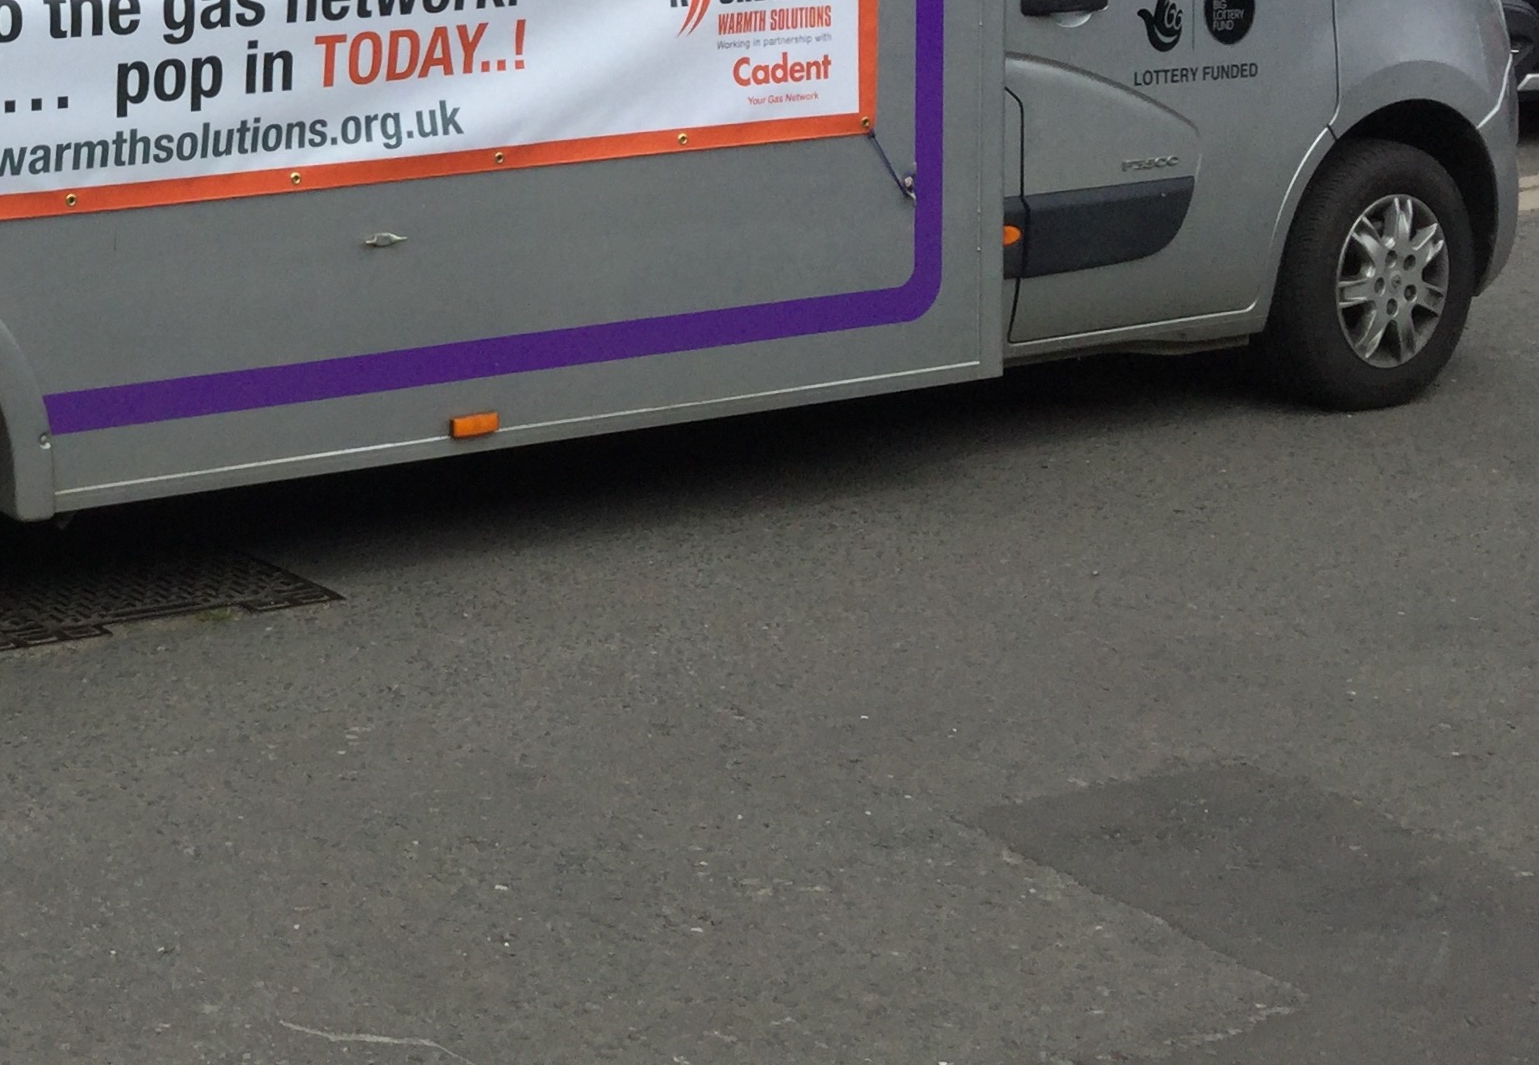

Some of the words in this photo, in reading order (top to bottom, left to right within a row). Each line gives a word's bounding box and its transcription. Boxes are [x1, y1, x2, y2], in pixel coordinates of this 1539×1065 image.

[717, 10, 767, 36] WARMTH
[770, 5, 832, 31] SOLUTIONS
[1212, 8, 1245, 21] LOTTERY
[1212, 19, 1235, 31] FUND
[717, 40, 751, 51] Working
[753, 38, 761, 47] in
[763, 35, 813, 48] partnership
[815, 33, 833, 44] with
[115, 53, 223, 118] pop
[245, 39, 294, 94] in
[732, 51, 832, 87] Cadent
[1134, 67, 1199, 87] LOTTERY
[1202, 62, 1259, 81] FUNDED
[748, 96, 766, 106] Your
[768, 94, 784, 104] Gas
[785, 92, 820, 102] Network
